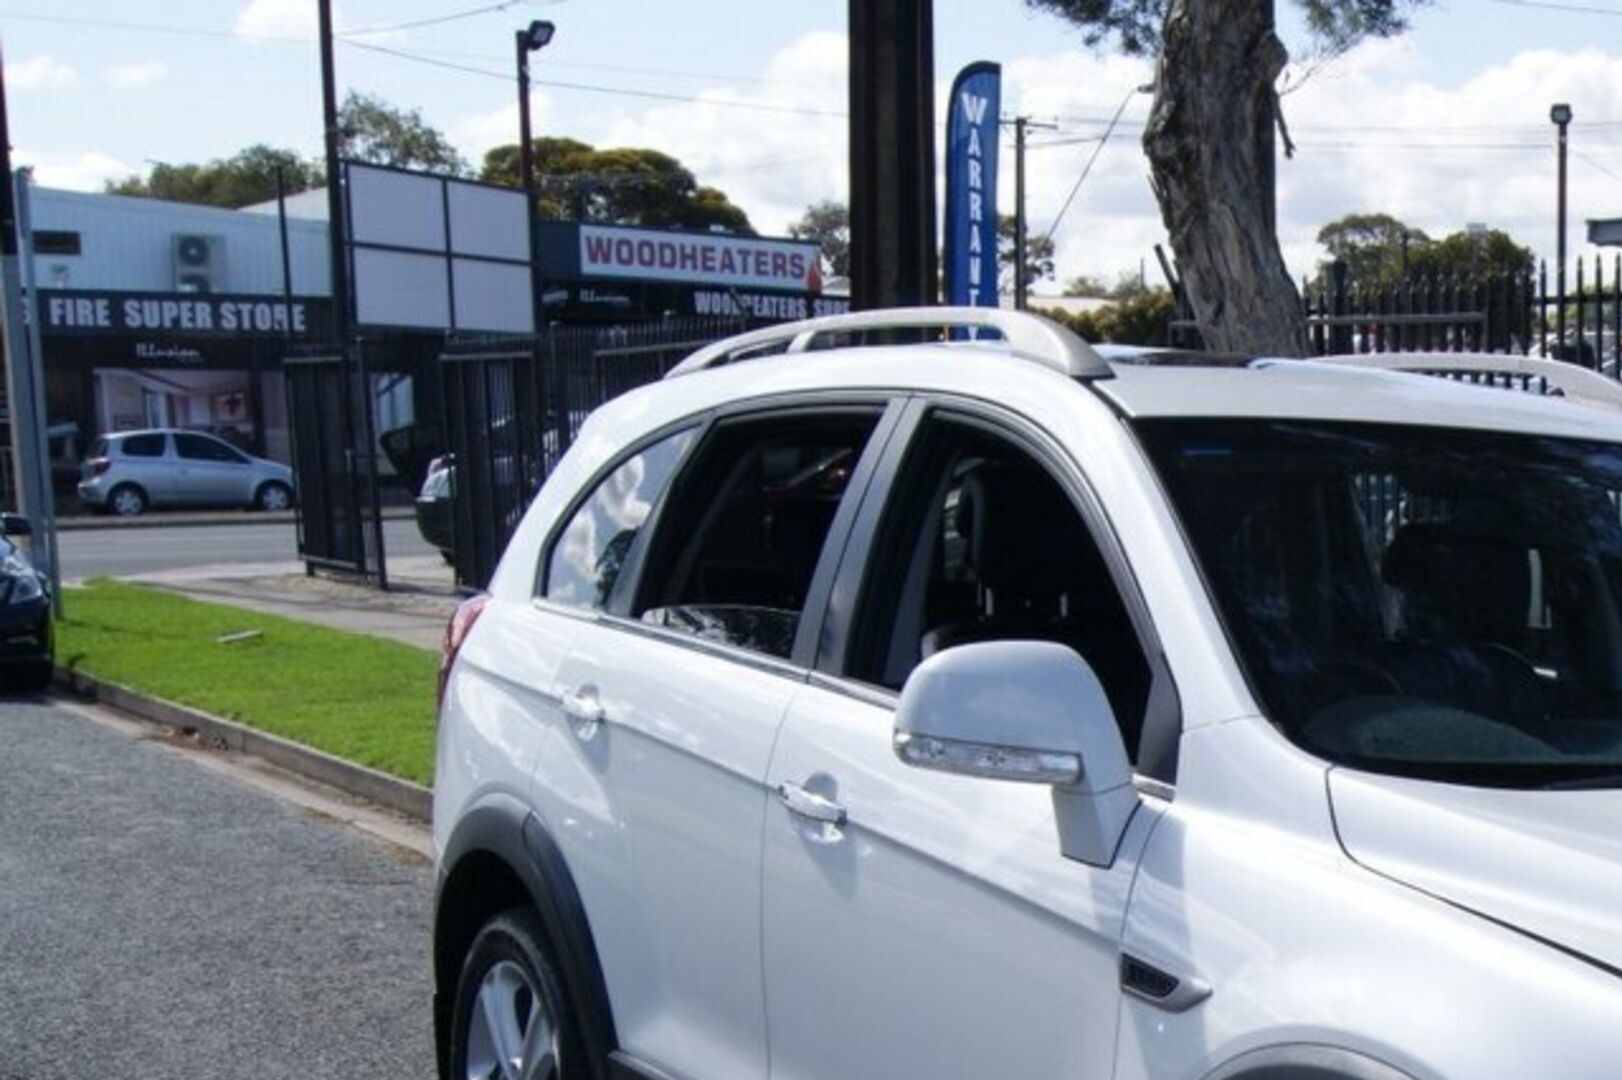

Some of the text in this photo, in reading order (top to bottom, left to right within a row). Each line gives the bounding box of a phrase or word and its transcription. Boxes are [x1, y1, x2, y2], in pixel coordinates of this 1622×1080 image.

[585, 235, 805, 279] WOODHEATERS
[50, 298, 110, 327] FIRE
[125, 301, 213, 329] SUPER
[220, 303, 305, 332] STORE
